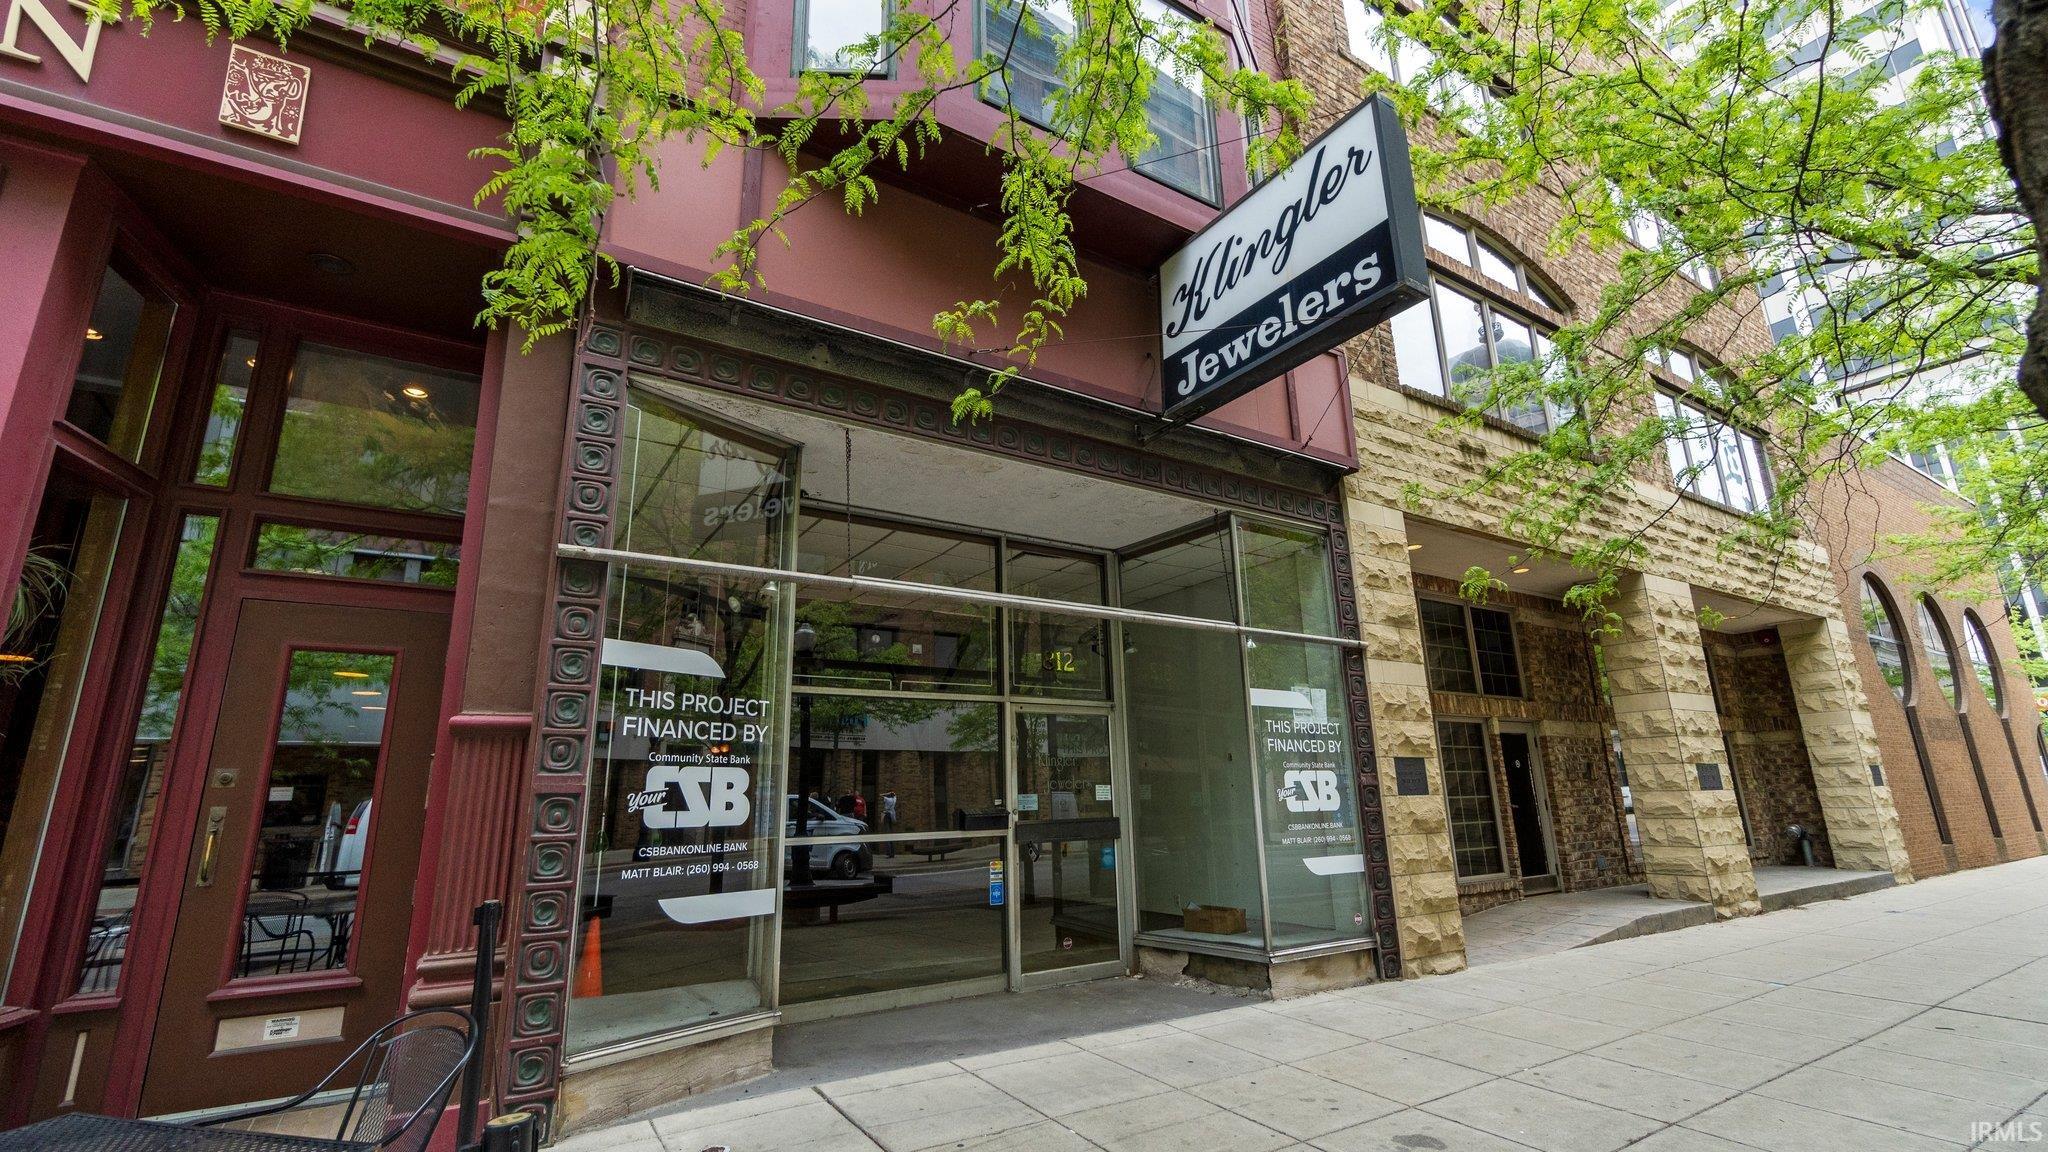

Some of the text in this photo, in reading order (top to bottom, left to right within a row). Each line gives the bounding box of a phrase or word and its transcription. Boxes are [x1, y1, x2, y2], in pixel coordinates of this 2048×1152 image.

[1166, 145, 1372, 338] Klingler
[1178, 252, 1382, 395] Jewelers
[625, 688, 769, 717] THIS PROJECT
[622, 716, 768, 742] FINANCED BY
[1265, 720, 1340, 735] THIS PROJECT
[1268, 739, 1341, 753] FINANCED BY
[649, 752, 750, 765] Community State Bank
[1283, 761, 1310, 769] Community
[627, 790, 668, 812] Your
[1277, 788, 1296, 801] Your
[639, 842, 748, 856] CSBBANKONLINE.BANK
[621, 868, 650, 879] MATT
[653, 866, 684, 877] BLAIR:
[687, 864, 710, 876] (260)
[712, 863, 729, 872] 994
[737, 861, 759, 870] 0568
